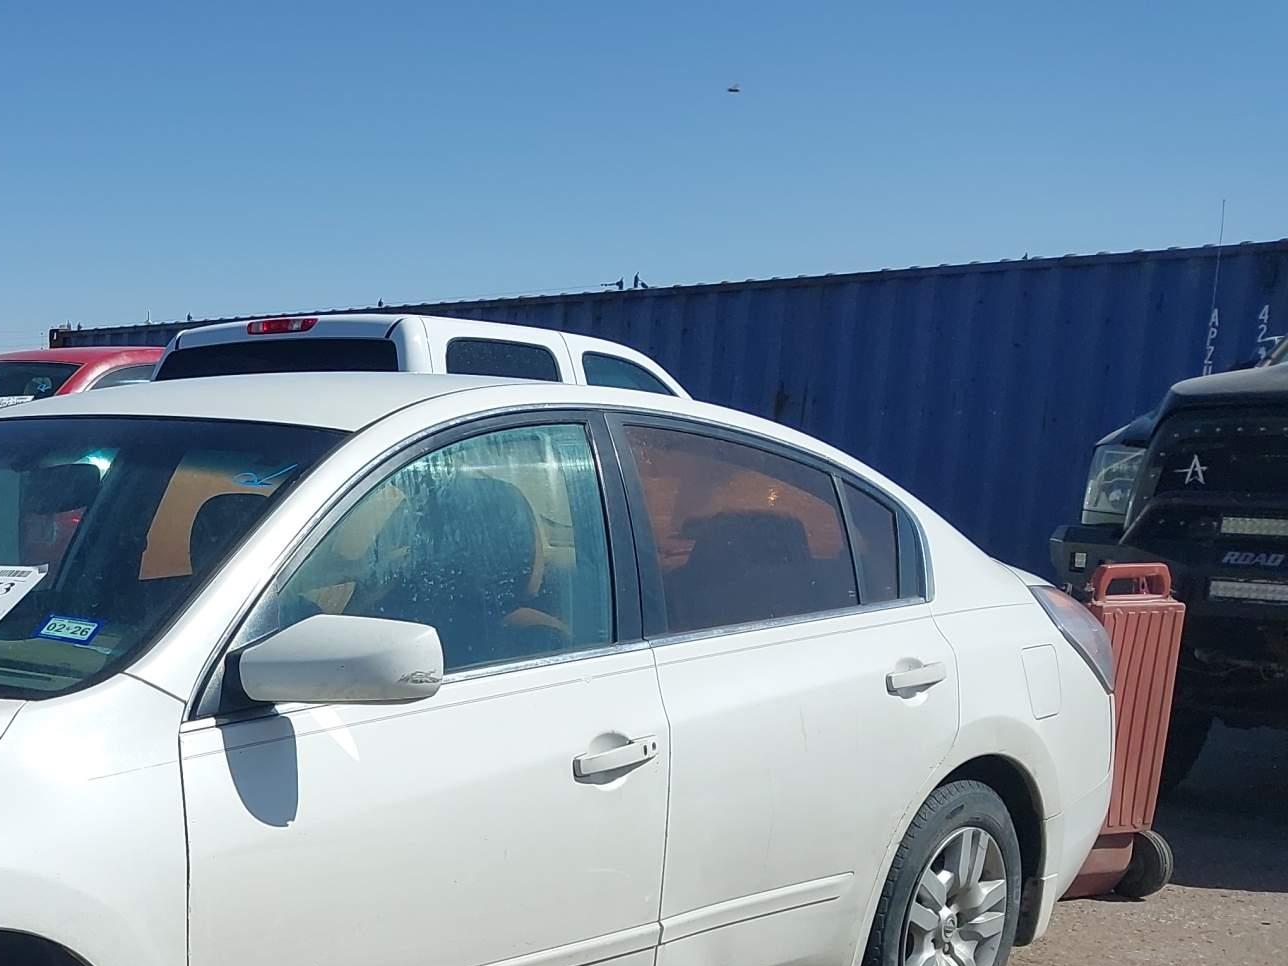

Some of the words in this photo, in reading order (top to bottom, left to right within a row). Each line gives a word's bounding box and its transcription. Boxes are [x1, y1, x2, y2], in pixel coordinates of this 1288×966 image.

[1222, 551, 1285, 567] ROAD
[46, 622, 66, 633] 02
[70, 625, 91, 637] 26
